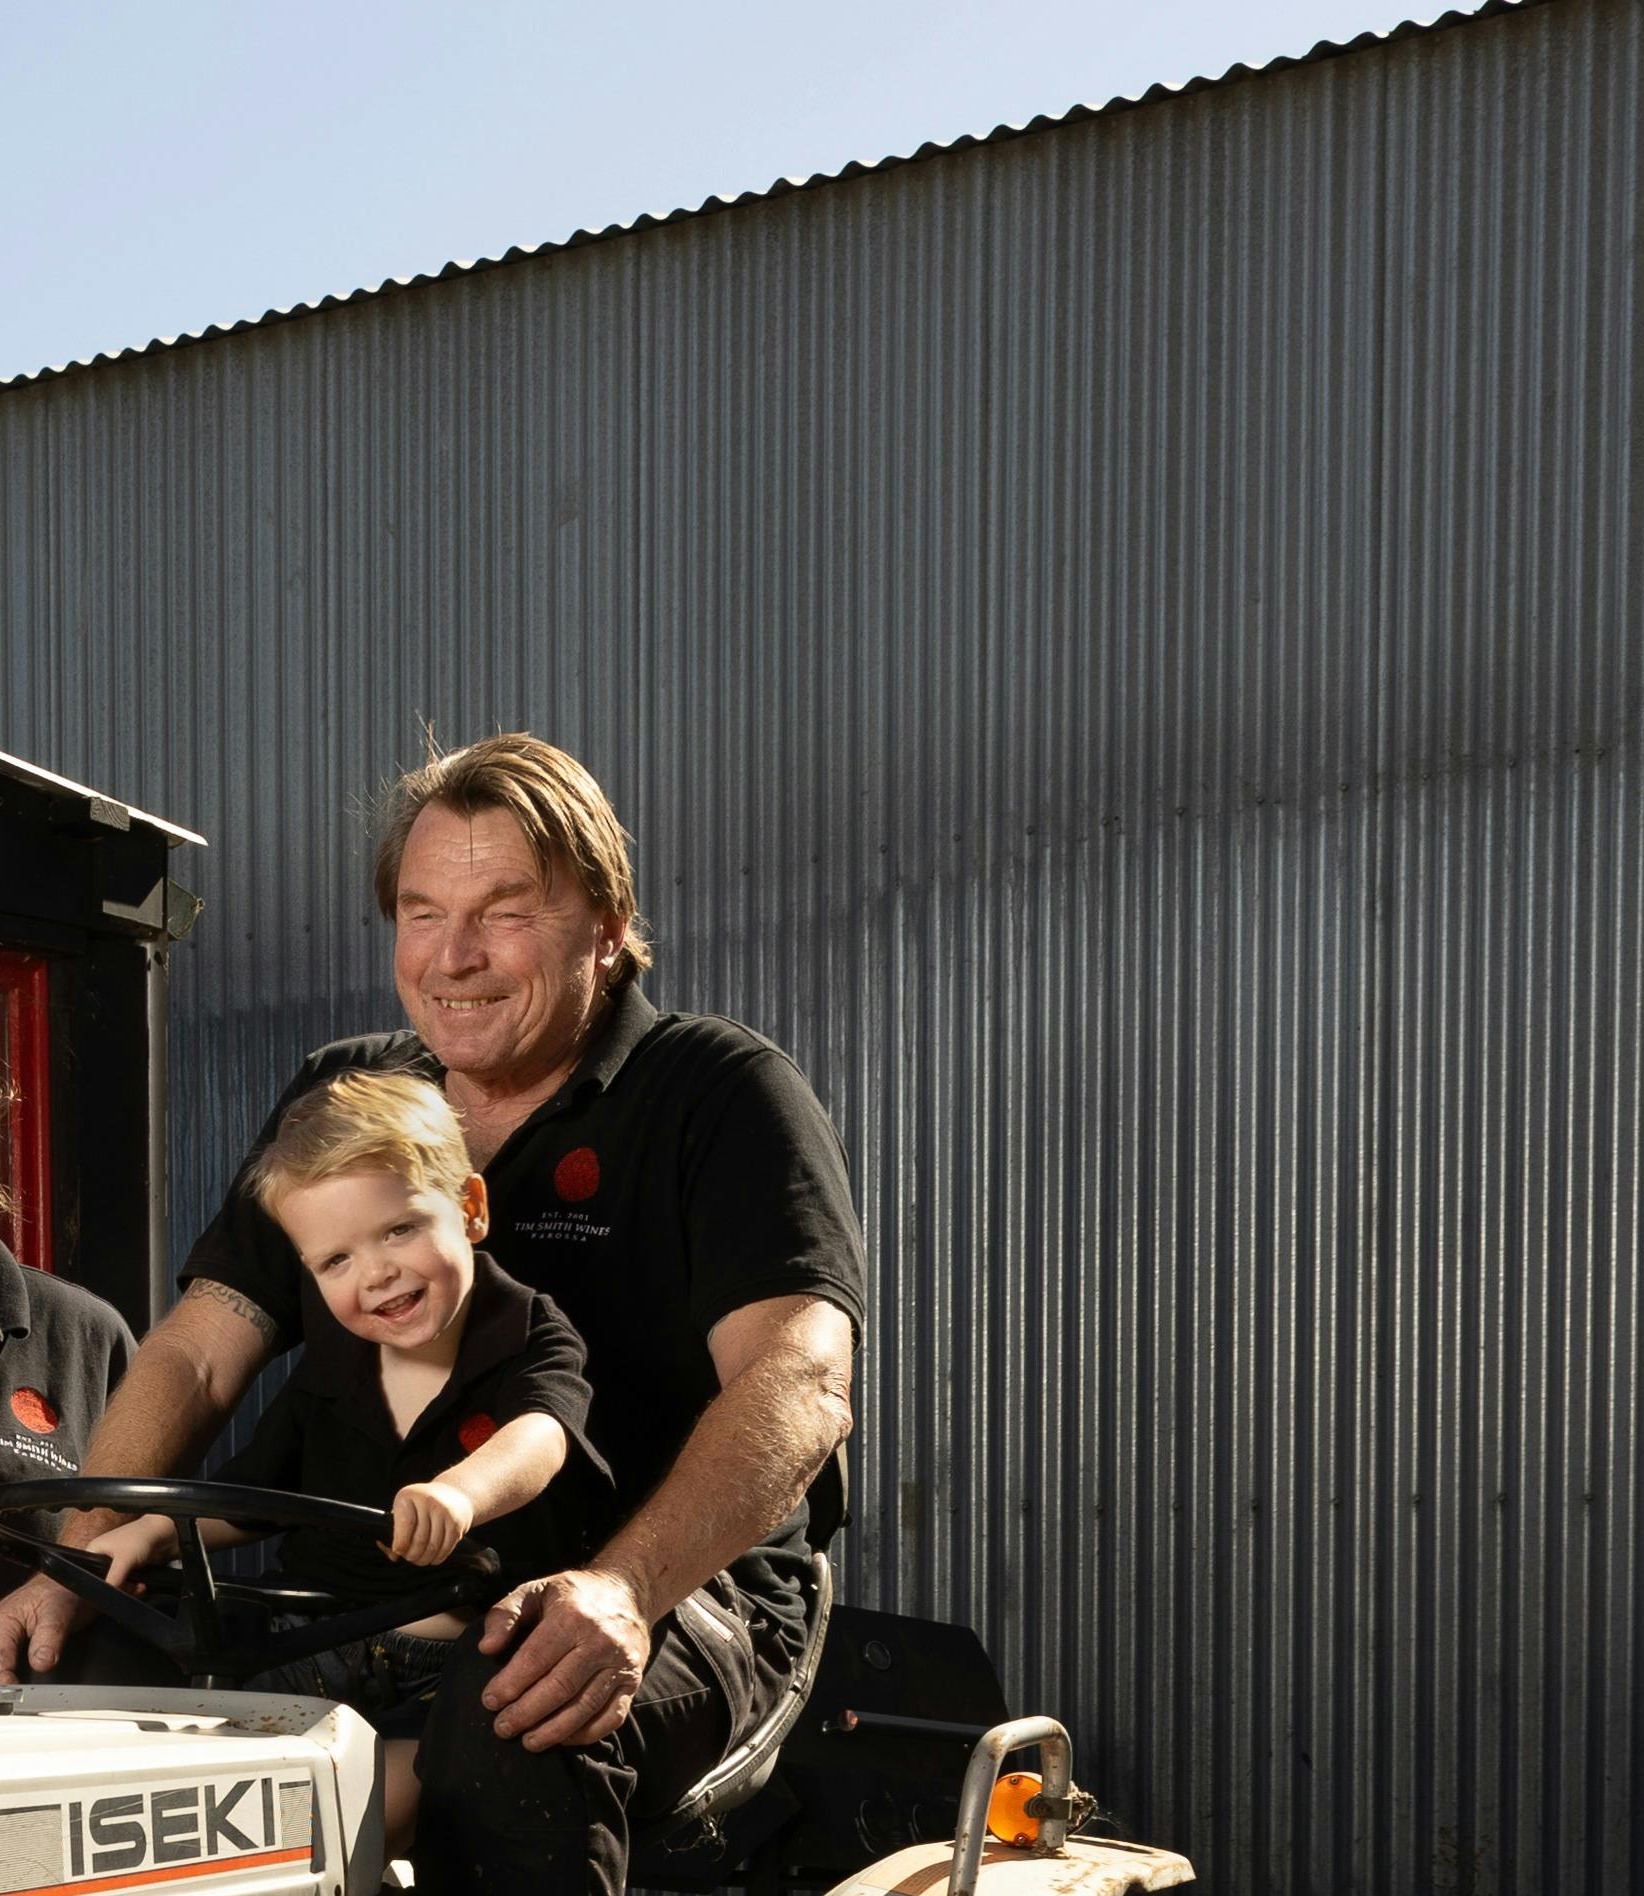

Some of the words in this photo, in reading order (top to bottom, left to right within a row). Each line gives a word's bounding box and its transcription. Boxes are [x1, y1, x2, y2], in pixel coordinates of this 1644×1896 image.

[515, 1222, 535, 1231] TIM
[537, 1222, 573, 1231] SMITH
[575, 1223, 611, 1236] WINES
[69, 1778, 275, 1877] ISEKI
